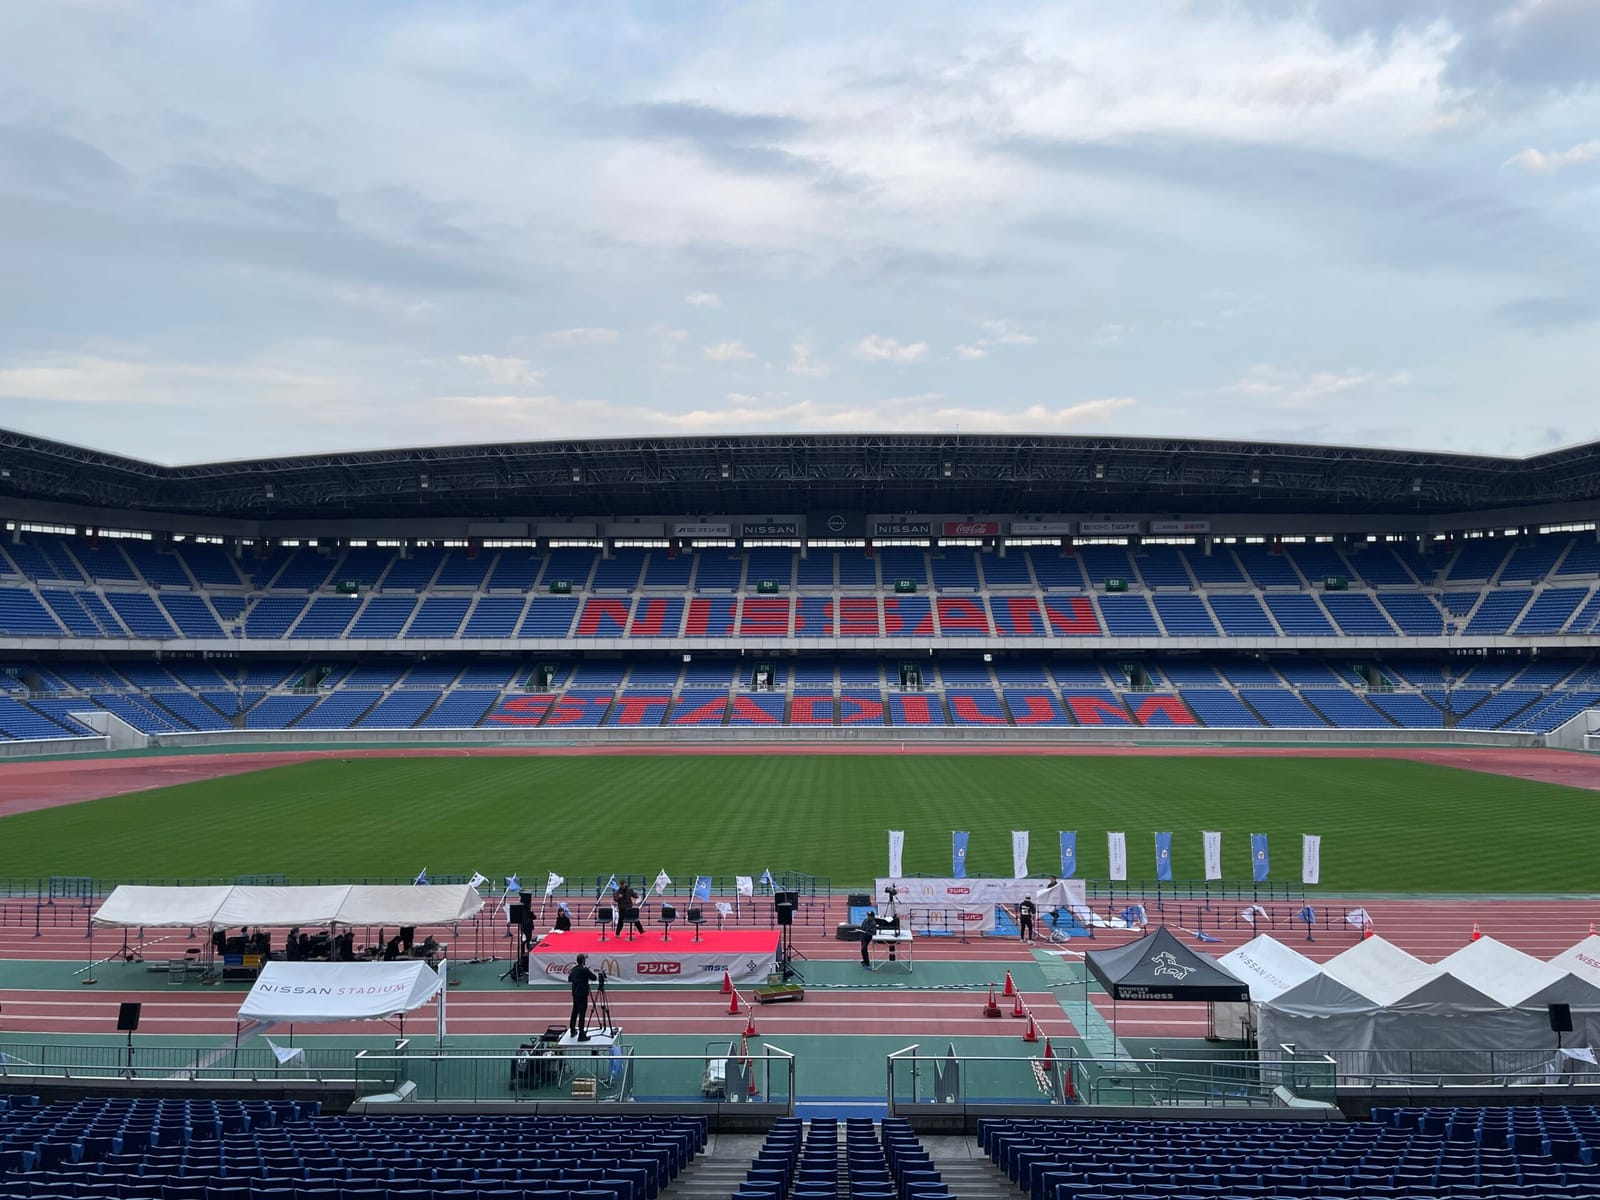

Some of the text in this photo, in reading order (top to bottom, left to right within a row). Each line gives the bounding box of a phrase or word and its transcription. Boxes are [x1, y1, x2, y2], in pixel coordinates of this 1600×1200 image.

[744, 525, 795, 534] NISSAN
[879, 525, 929, 533] NISSAN
[955, 523, 987, 535] Coca-Cola
[577, 597, 1101, 636] NISSAN
[488, 694, 1198, 725] STADIUM
[639, 963, 680, 973] フジパン
[1237, 951, 1265, 976] NISSAN
[259, 983, 409, 996] NISSAN STADIUM
[1118, 990, 1175, 999] Wellness
